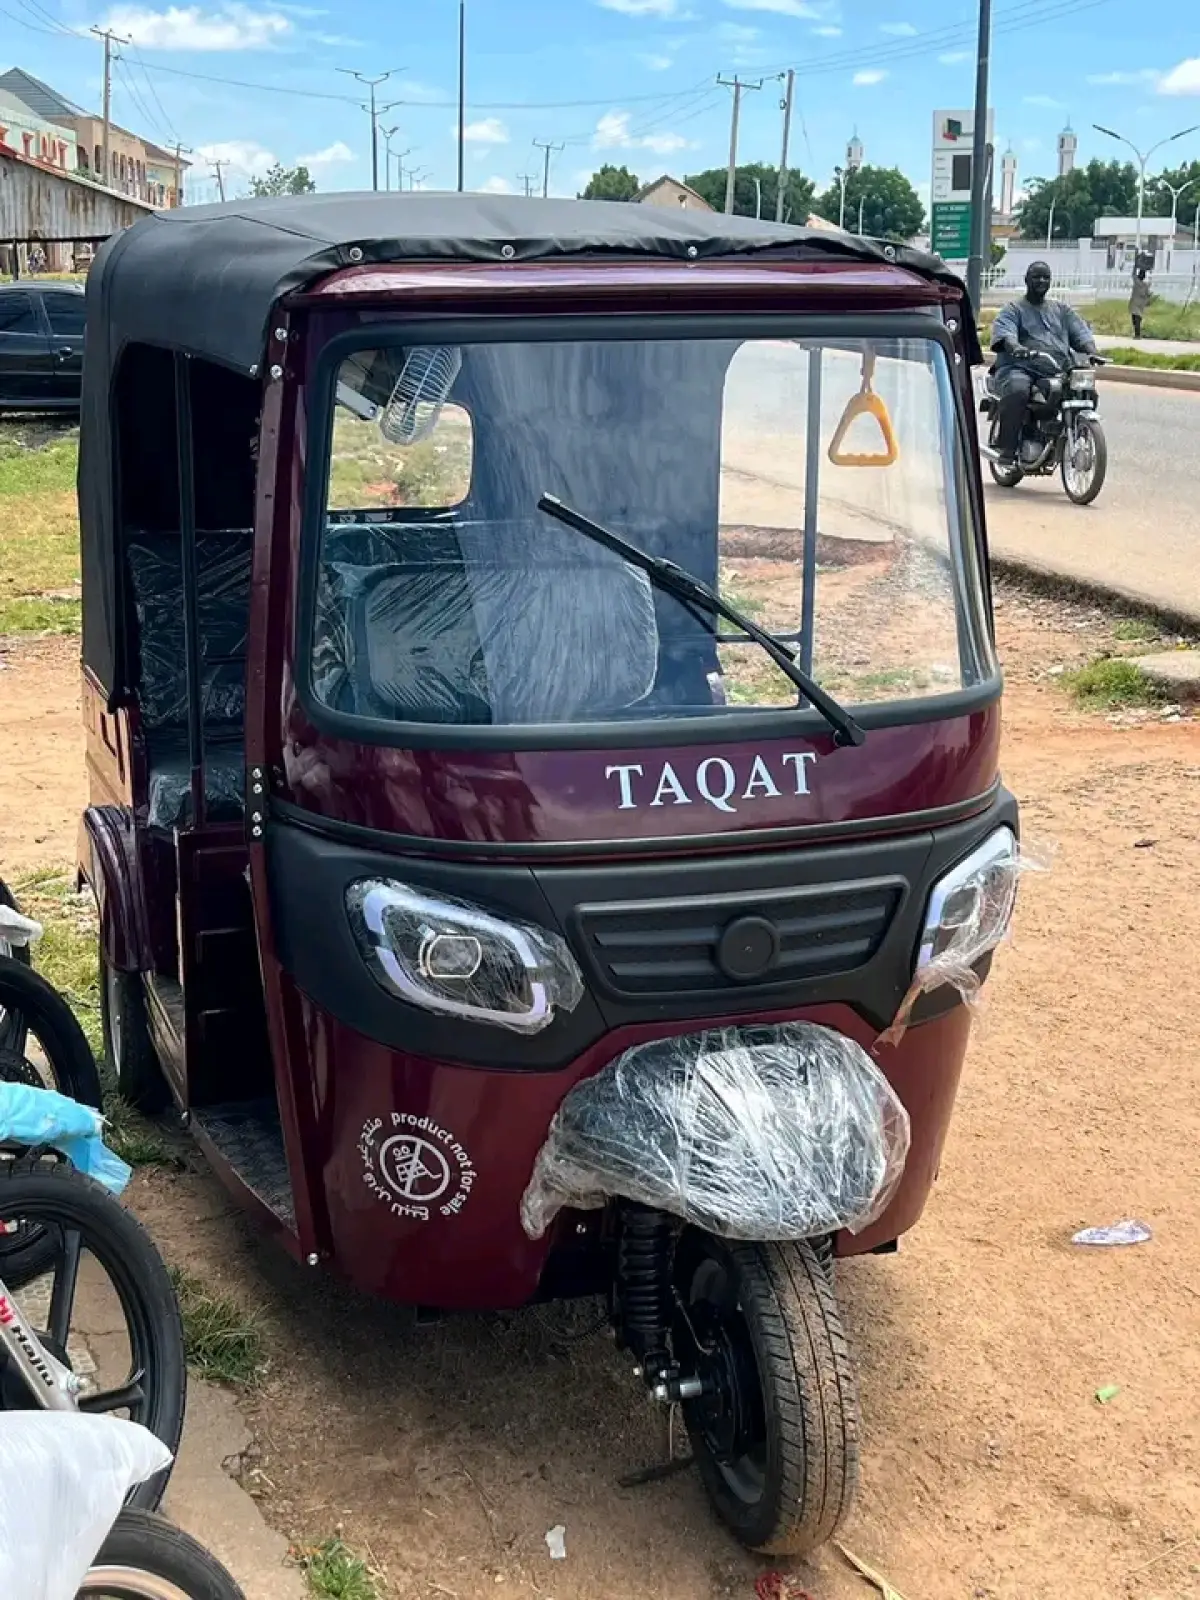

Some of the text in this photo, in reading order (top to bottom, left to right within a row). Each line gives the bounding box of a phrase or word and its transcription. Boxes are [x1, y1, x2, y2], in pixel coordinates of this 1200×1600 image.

[604, 752, 818, 813] TAQAT
[360, 1117, 383, 1146] منتج
[390, 1111, 478, 1216] product not for sale
